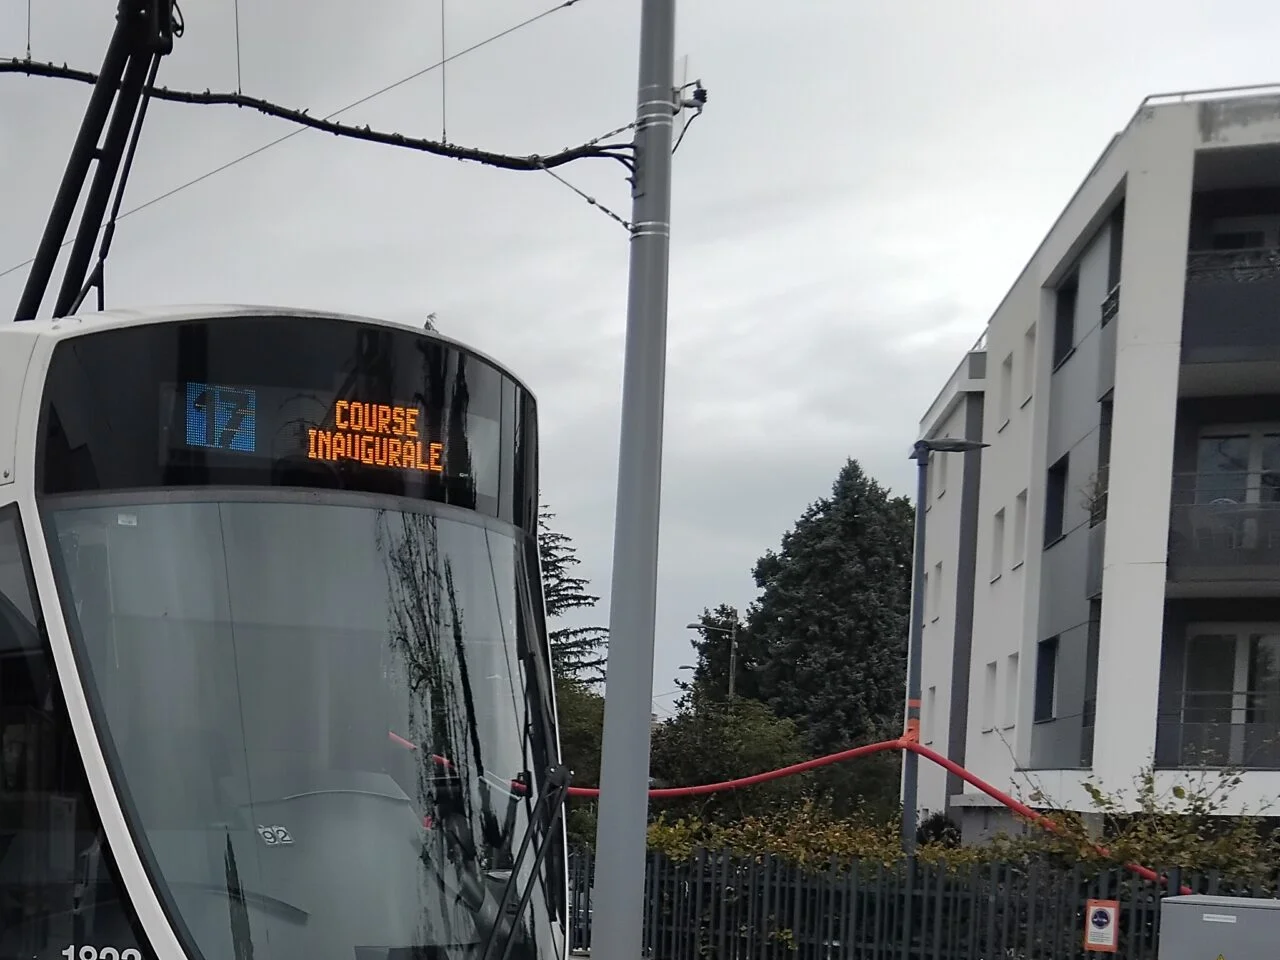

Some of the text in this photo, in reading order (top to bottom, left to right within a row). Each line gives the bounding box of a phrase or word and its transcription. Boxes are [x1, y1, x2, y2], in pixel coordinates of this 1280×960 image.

[194, 387, 251, 449] 17
[335, 400, 419, 437] COURSE
[308, 429, 443, 471] INAUGURALE
[262, 829, 293, 844] 92
